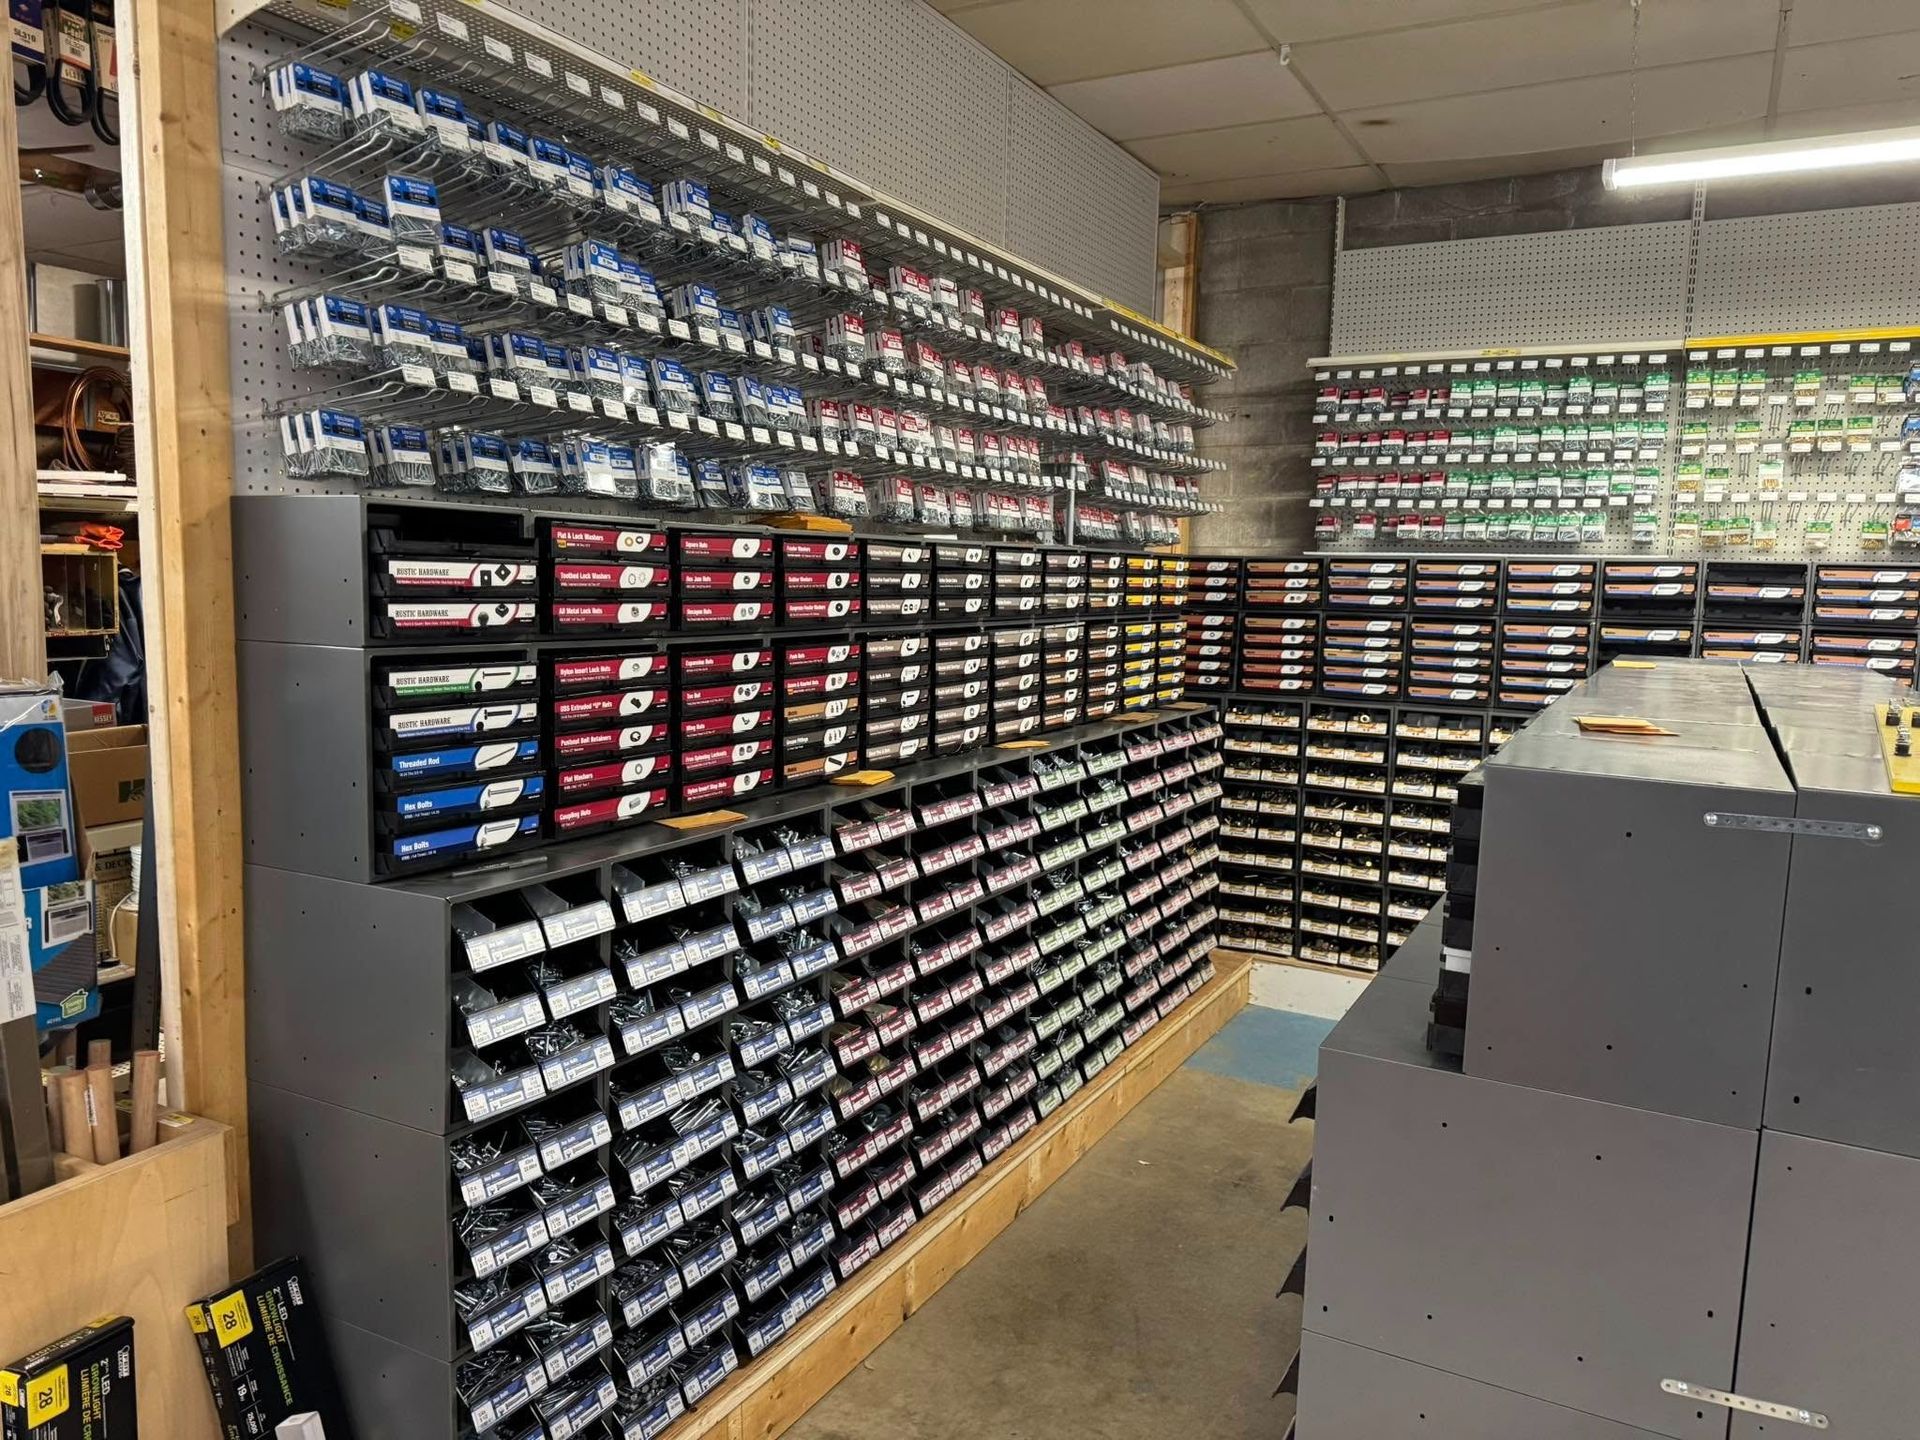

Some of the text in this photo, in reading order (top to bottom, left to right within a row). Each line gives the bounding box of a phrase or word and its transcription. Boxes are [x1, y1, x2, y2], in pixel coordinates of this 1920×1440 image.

[396, 676, 450, 685] RUSTIC HARDWARE
[571, 702, 592, 712] Extruded
[398, 717, 451, 729] RUSTIC HARDWARE
[399, 757, 440, 769] Threaded Rod
[574, 773, 593, 781] Washers
[418, 800, 432, 809] Bolts
[414, 841, 429, 850] Bolts
[265, 1291, 286, 1342] GROWLIGHT
[277, 1301, 288, 1320] LED
[222, 1310, 238, 1330] 28
[256, 1295, 294, 1406] LUMIÈRE DE CROISSANCE
[80, 1369, 91, 1410] LUMIÈRE
[91, 1363, 101, 1420] GROWLIGHT
[101, 1374, 110, 1395] LED
[39, 1387, 53, 1409] 28
[82, 1410, 91, 1424] DE
